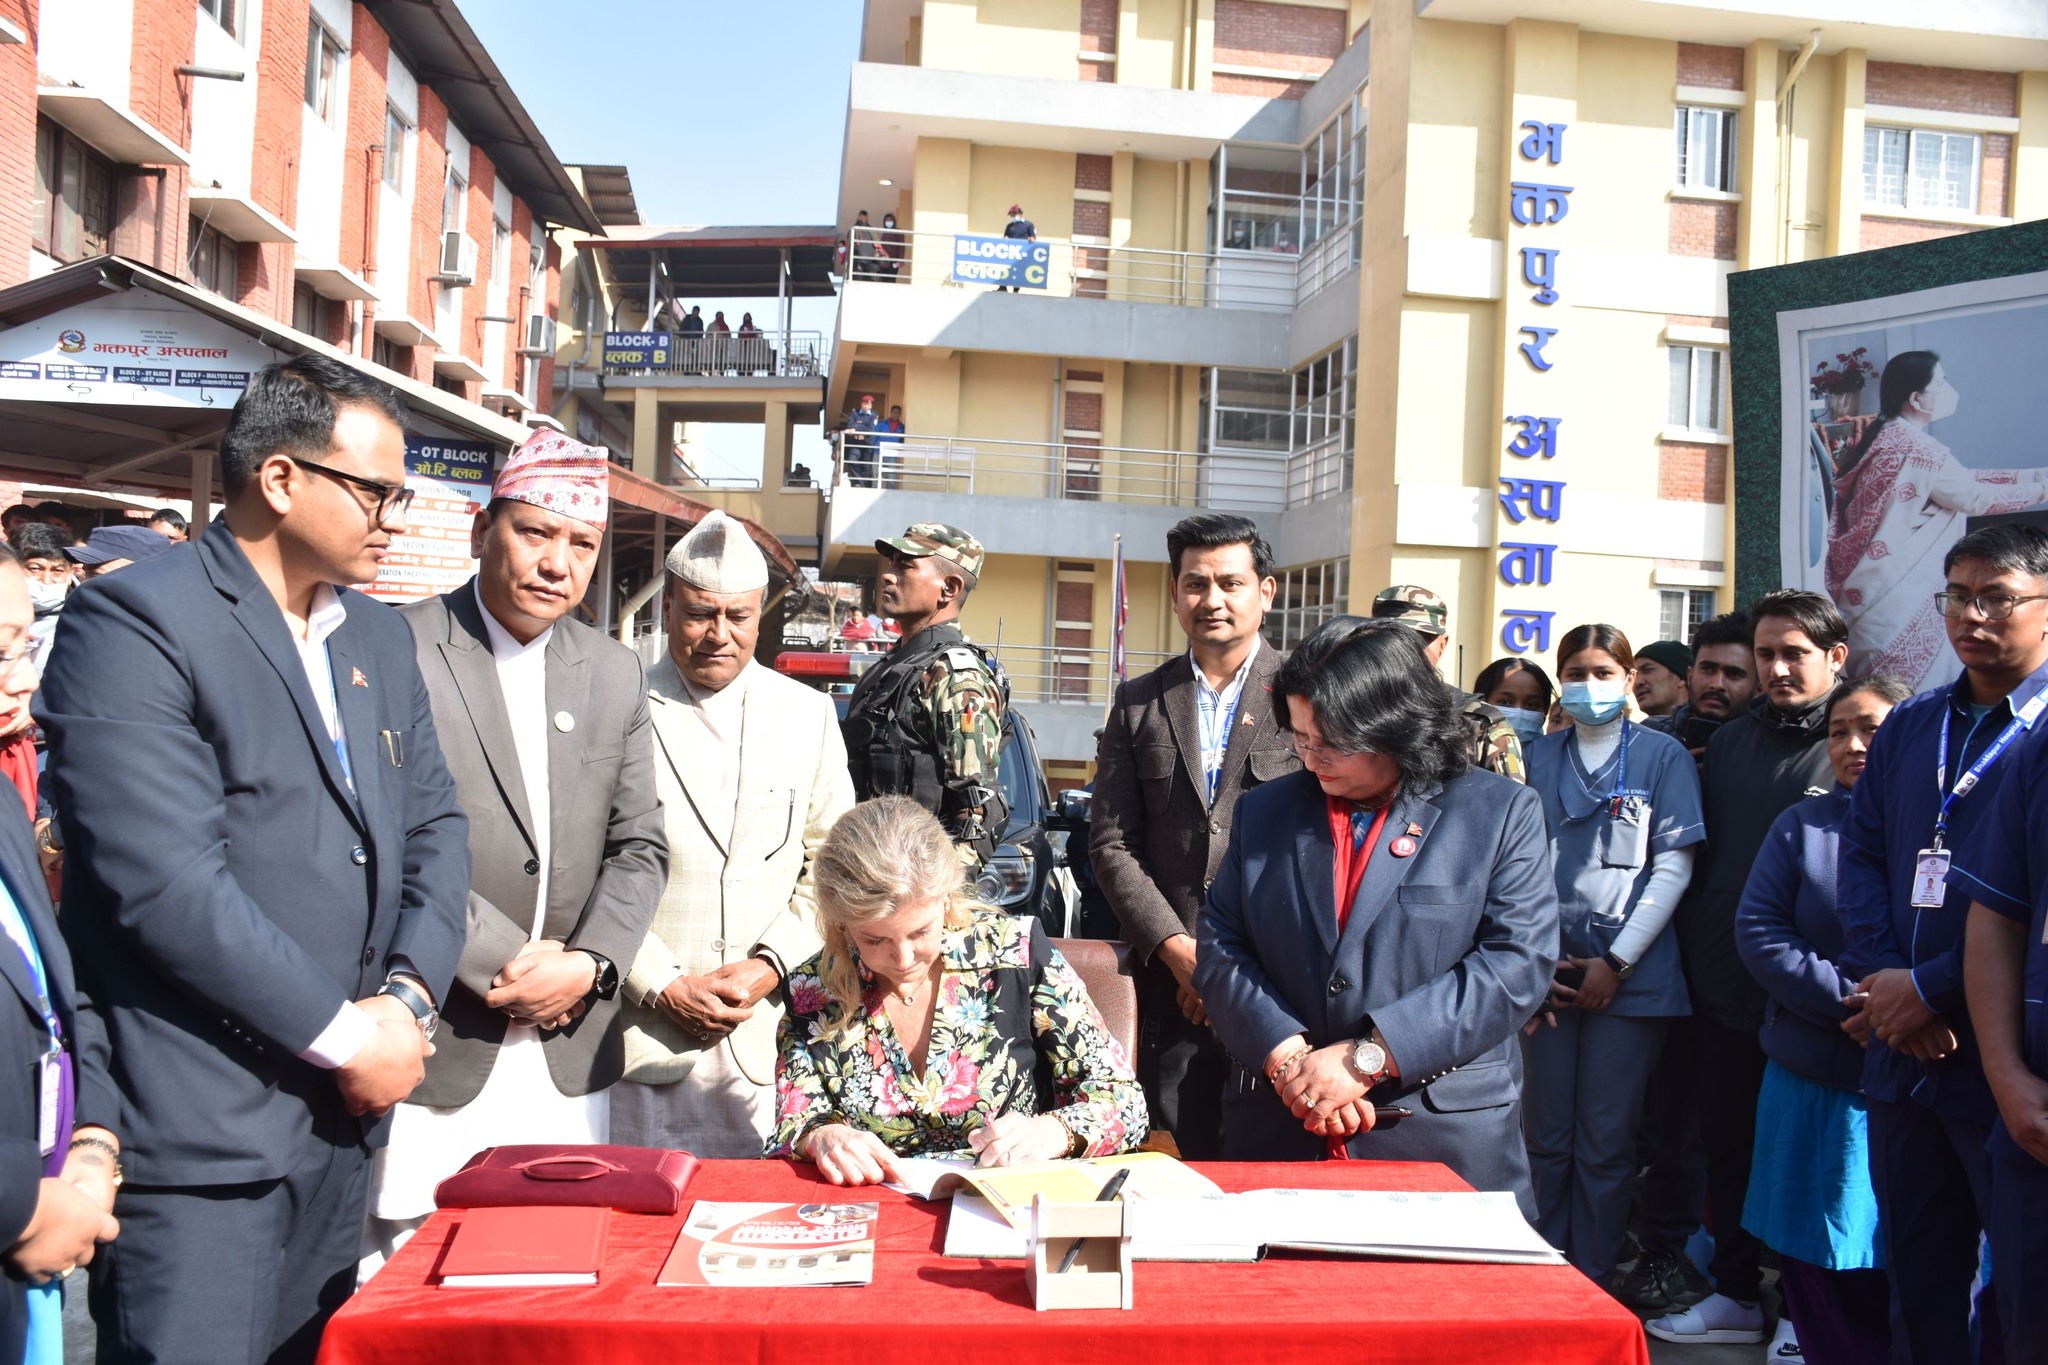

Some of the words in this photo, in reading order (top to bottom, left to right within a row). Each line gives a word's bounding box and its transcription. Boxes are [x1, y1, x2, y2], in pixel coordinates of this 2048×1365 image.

[1033, 247, 1048, 262] C
[1024, 265, 1045, 284] C
[658, 335, 668, 346] B
[93, 342, 151, 358] भक्तपुर
[156, 345, 229, 359] अस्पताल
[653, 350, 666, 364] B
[421, 446, 440, 459] OT
[442, 448, 488, 464] BLOCK
[451, 467, 483, 480] ब्लक
[1973, 743, 2002, 773] Bhaktapur
[1998, 719, 2022, 744] Hospital
